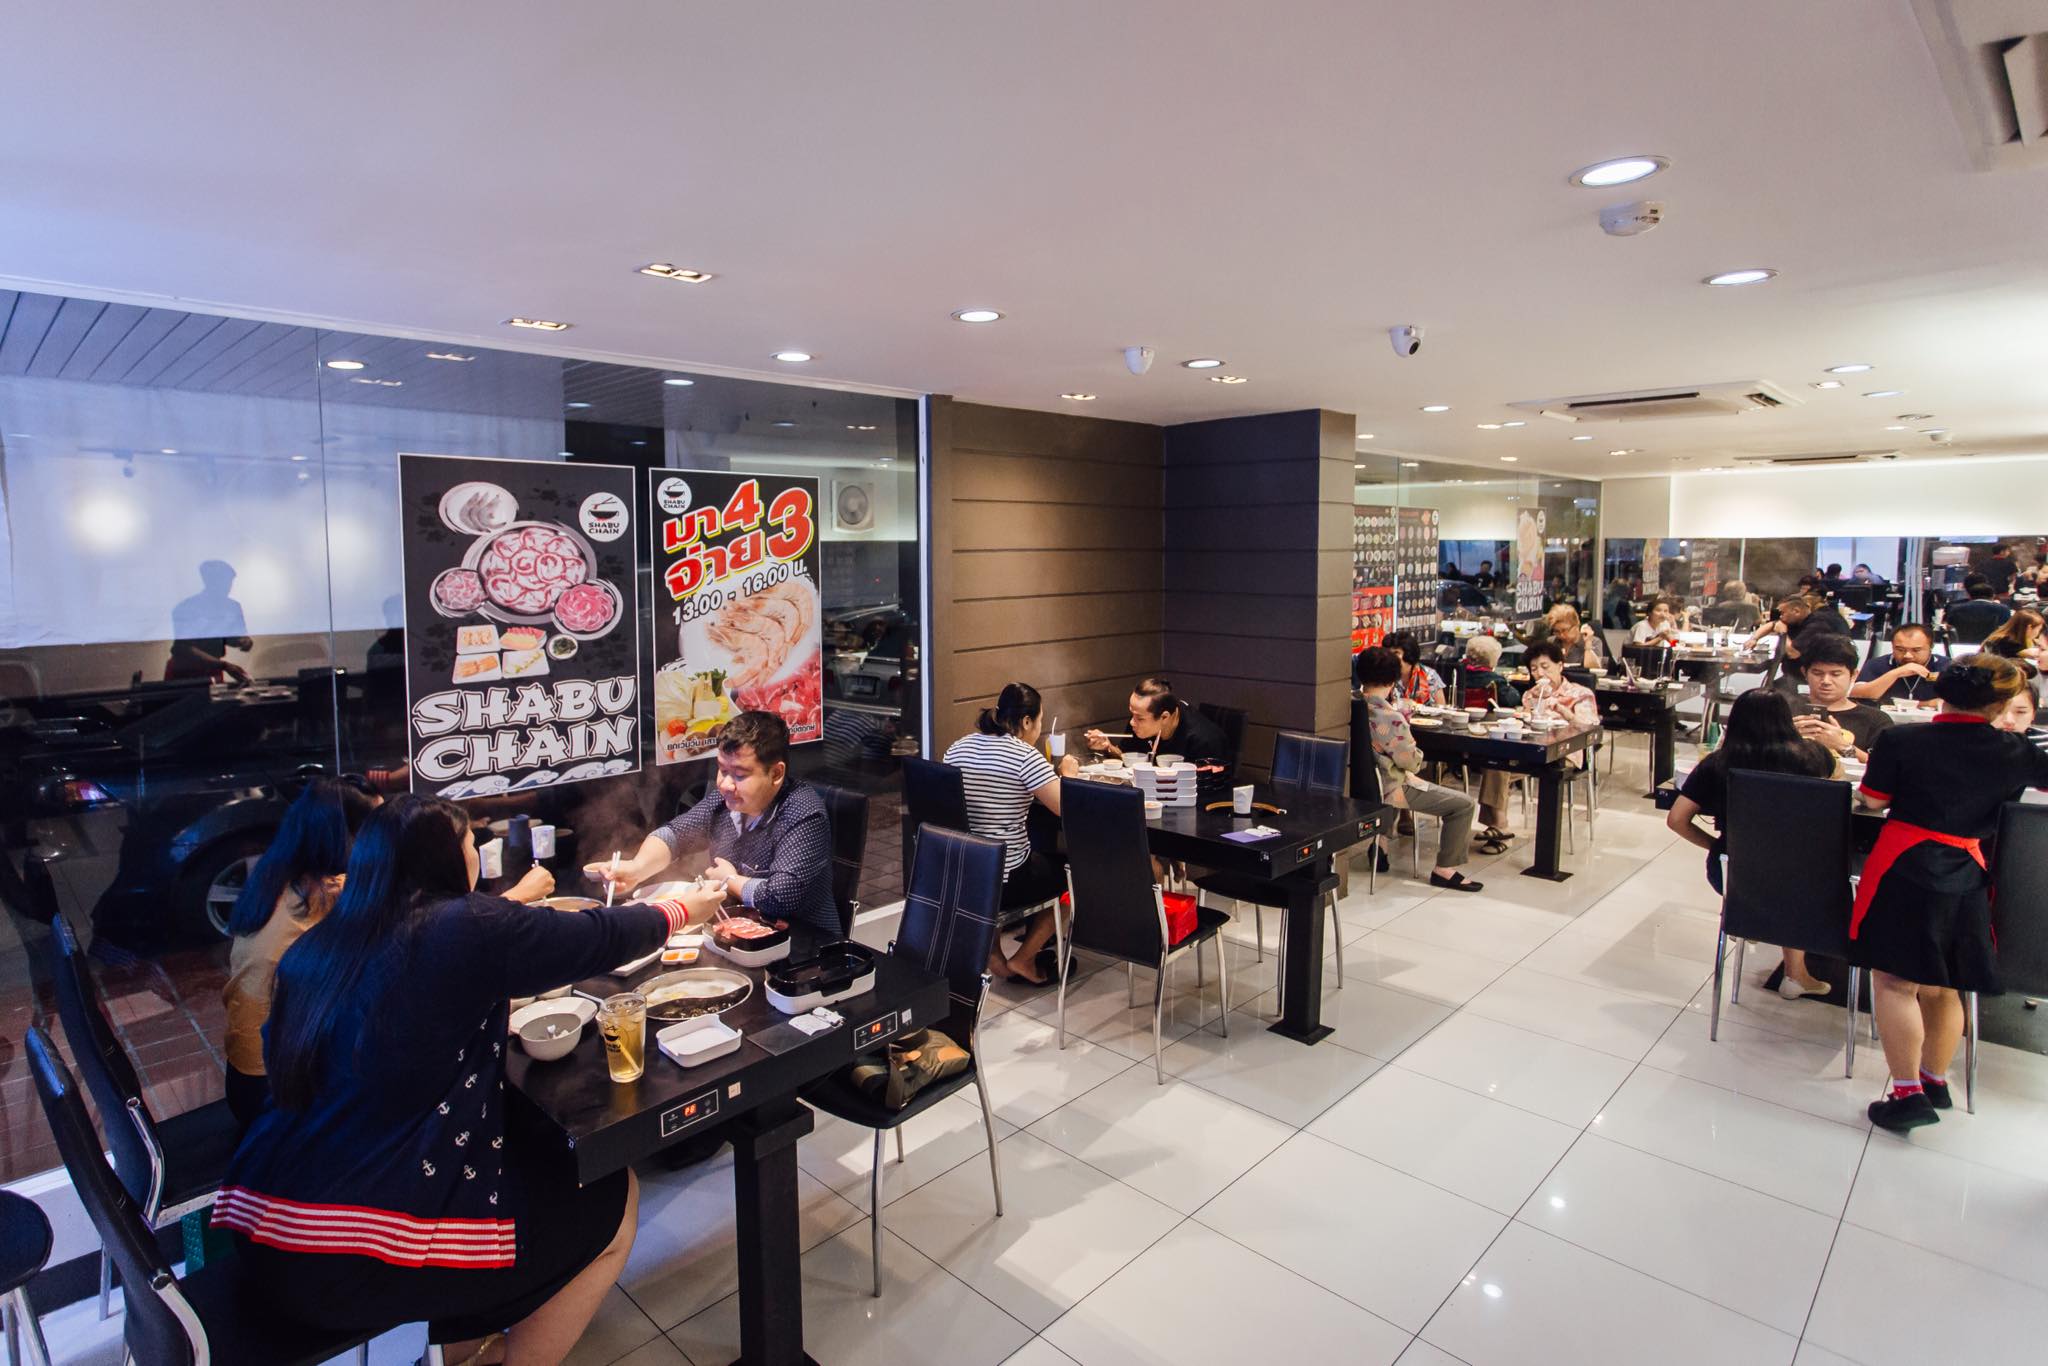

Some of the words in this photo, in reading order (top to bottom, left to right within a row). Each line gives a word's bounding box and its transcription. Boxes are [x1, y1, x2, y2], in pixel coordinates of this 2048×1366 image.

[663, 506, 721, 554] มา
[722, 478, 764, 532] 4
[664, 529, 766, 601] จ่าย
[766, 487, 815, 561] 3
[672, 589, 723, 626] 13.00
[742, 562, 789, 597] 16.00
[1515, 595, 1543, 614] CHAIN
[1517, 581, 1545, 597] SHABU
[412, 675, 636, 736] SHABU
[413, 717, 636, 780] CHAIN
